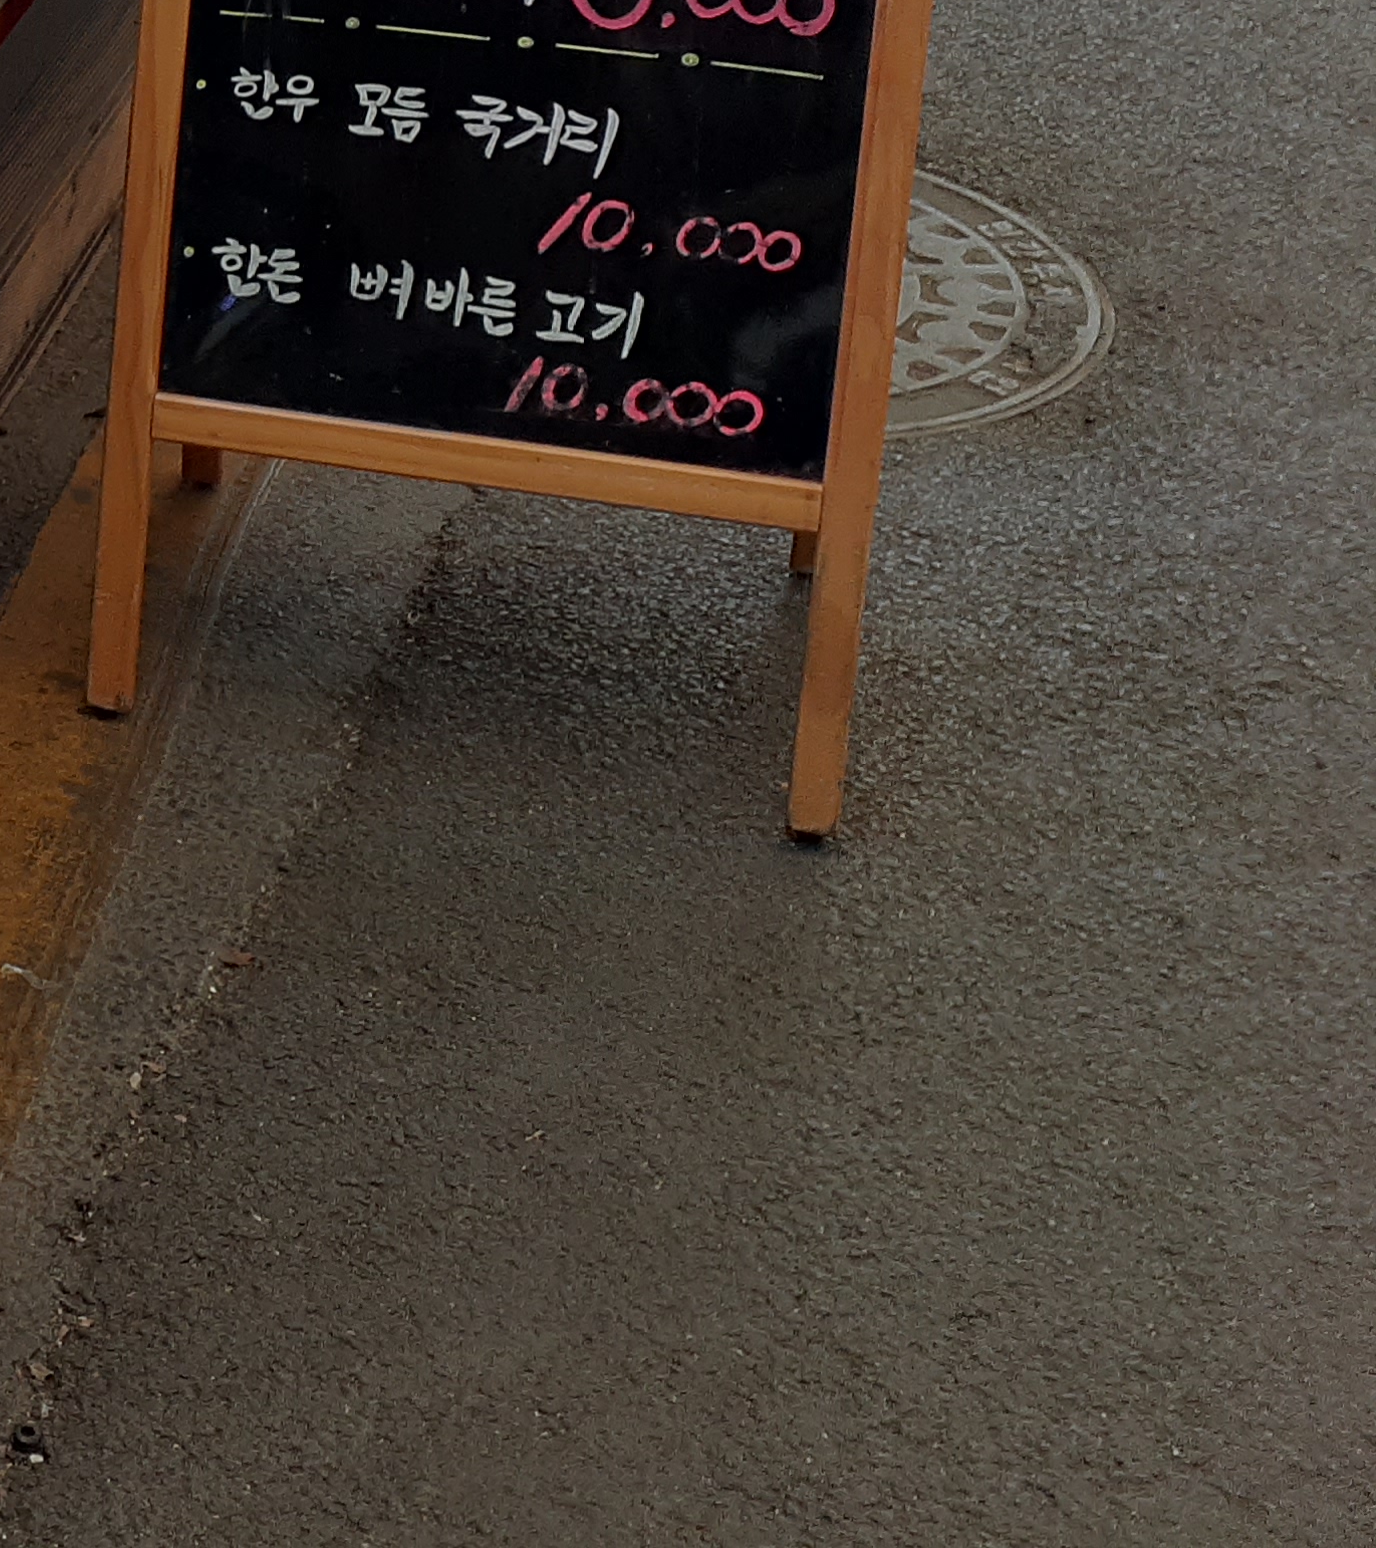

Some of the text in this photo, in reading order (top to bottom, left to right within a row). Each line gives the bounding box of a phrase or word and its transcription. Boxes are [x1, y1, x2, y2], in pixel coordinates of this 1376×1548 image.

[231, 66, 620, 180] 한우 모듬 국거리
[535, 290, 645, 360] 고기
